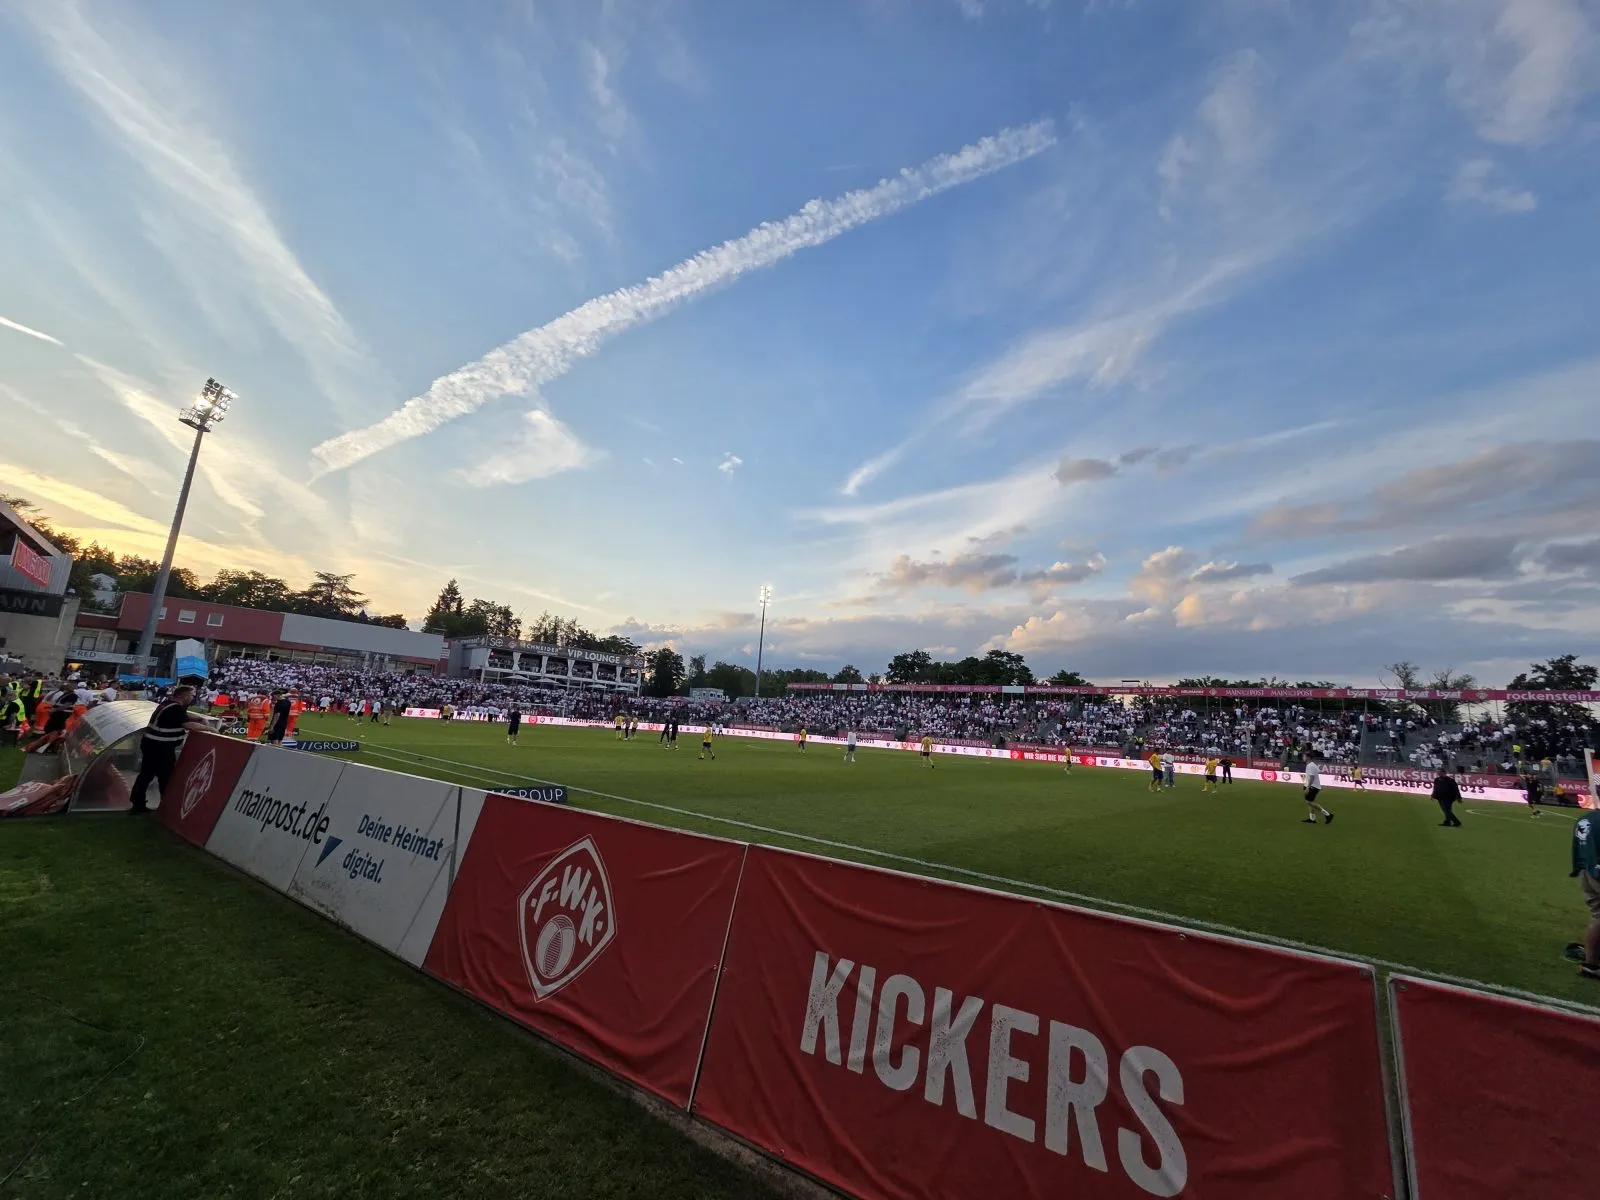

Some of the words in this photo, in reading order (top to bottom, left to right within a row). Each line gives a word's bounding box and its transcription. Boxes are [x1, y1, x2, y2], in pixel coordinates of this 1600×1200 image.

[568, 648, 583, 658] VIP
[585, 652, 620, 664] LOUNGE
[1023, 752, 1034, 760] WIR
[1035, 753, 1047, 761] SIND
[234, 786, 330, 844] mainpost.de
[356, 814, 393, 844] Deine
[391, 825, 444, 862] Heimat
[342, 848, 385, 884] digital.
[800, 950, 1188, 1198] KICKERS
